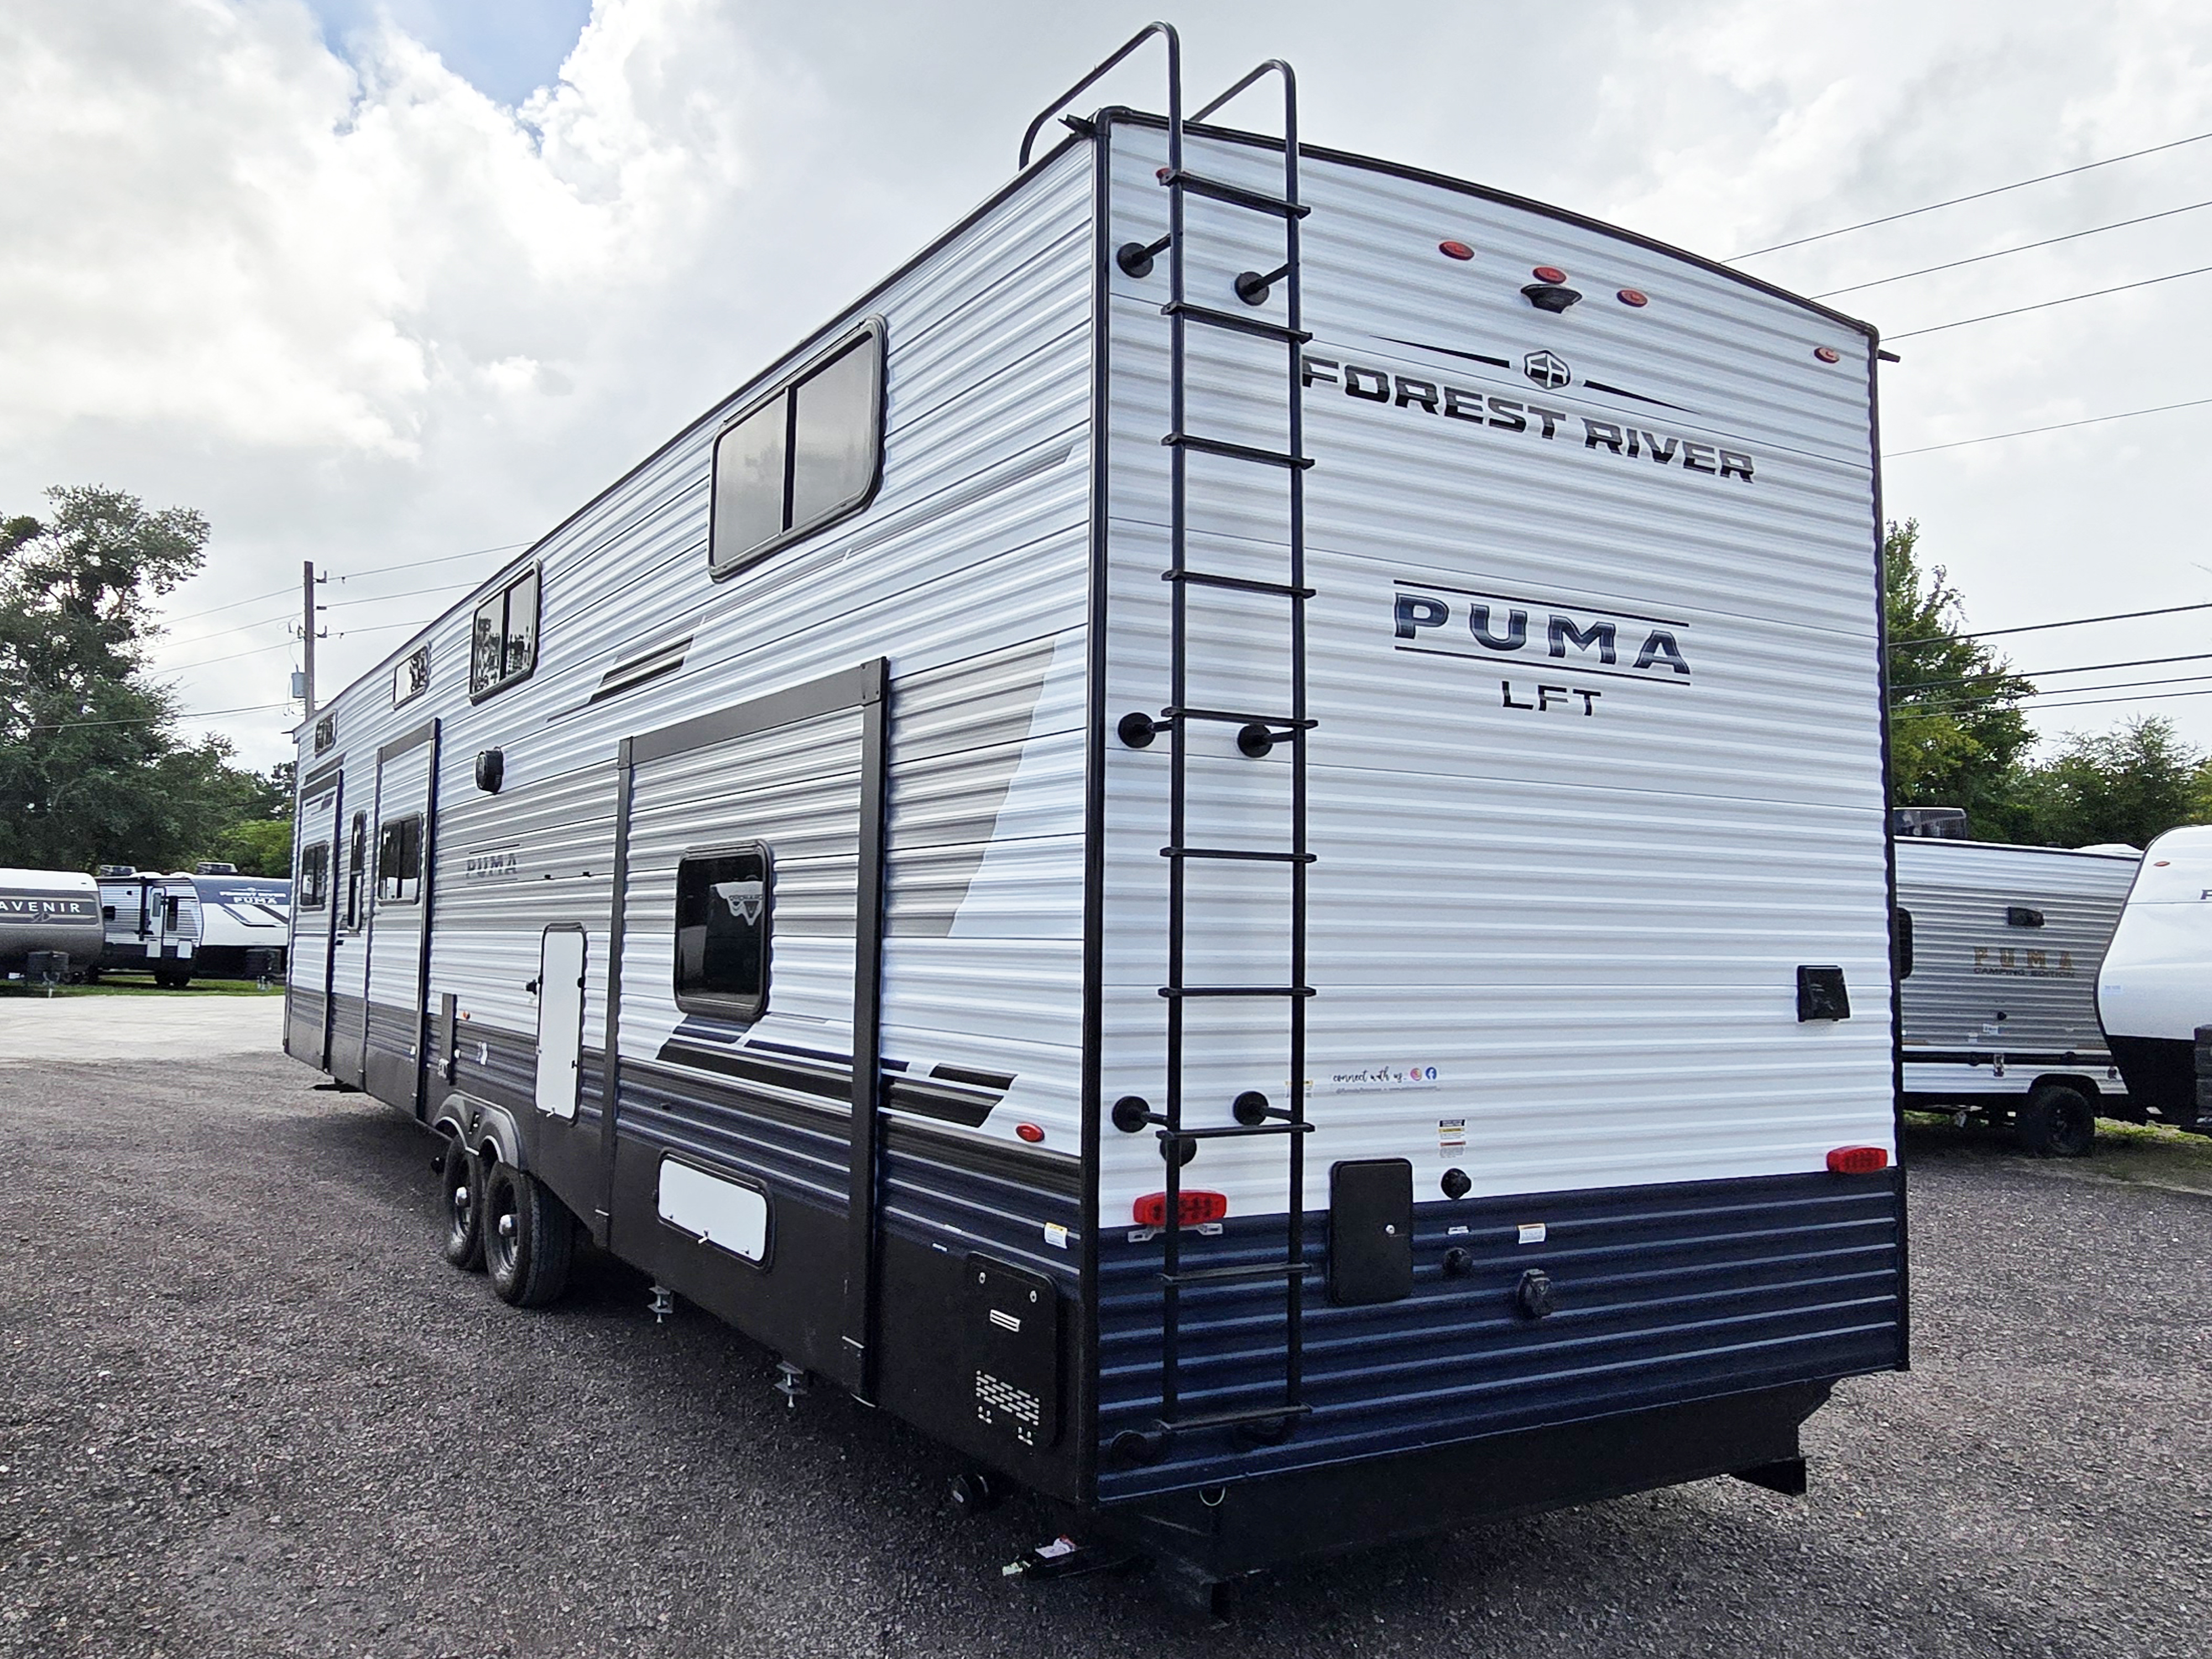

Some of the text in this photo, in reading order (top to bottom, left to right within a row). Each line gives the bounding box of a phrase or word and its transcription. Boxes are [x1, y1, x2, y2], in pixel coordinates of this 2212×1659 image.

[1302, 354, 1754, 484] FOREST RIVER
[1394, 592, 1691, 675] PUMA
[1501, 681, 1601, 716] LFT
[466, 853, 518, 879] PUMA
[0, 900, 81, 913] AVENIR
[1974, 946, 2074, 971] PUMA
[1973, 968, 2075, 978] CAMPING EDITION
[1333, 1069, 1368, 1082] connect
